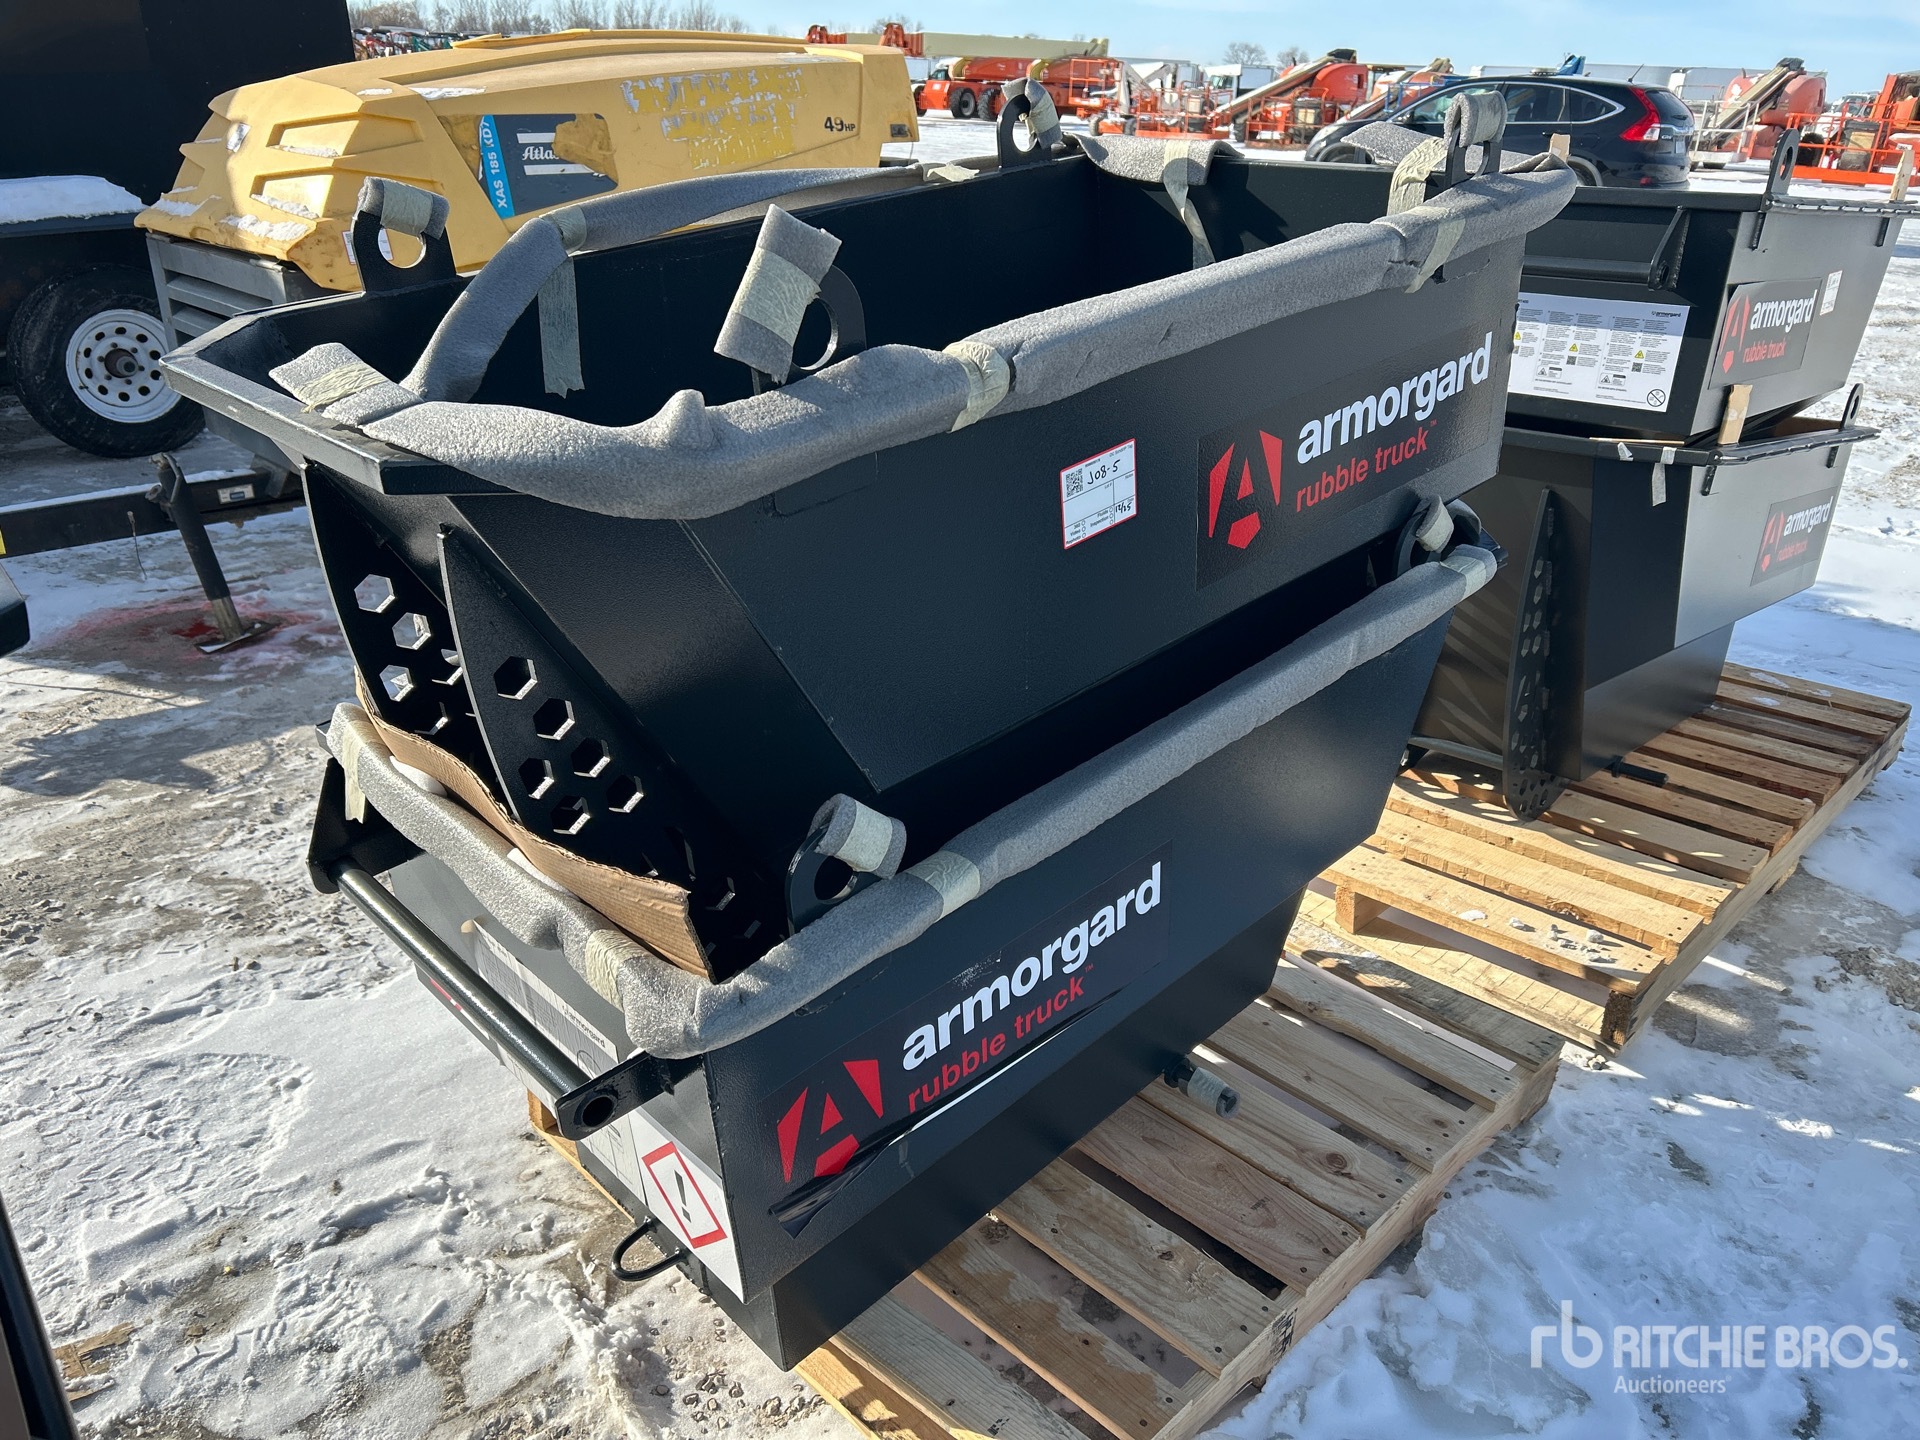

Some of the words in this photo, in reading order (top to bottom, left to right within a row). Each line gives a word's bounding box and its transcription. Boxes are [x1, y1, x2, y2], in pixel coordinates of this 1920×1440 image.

[488, 151, 500, 175] 185
[494, 179, 508, 208] XAS
[1750, 289, 1818, 333] armorgard
[1743, 340, 1767, 363] rubble
[1767, 338, 1787, 359] truck
[1296, 331, 1493, 464] armorgard
[1296, 457, 1369, 513] rubble
[1374, 427, 1428, 474] truck
[1783, 495, 1834, 537] armorgard
[902, 861, 1162, 1071] armorgard
[908, 1030, 1006, 1114] rubble
[1013, 975, 1085, 1040] truck
